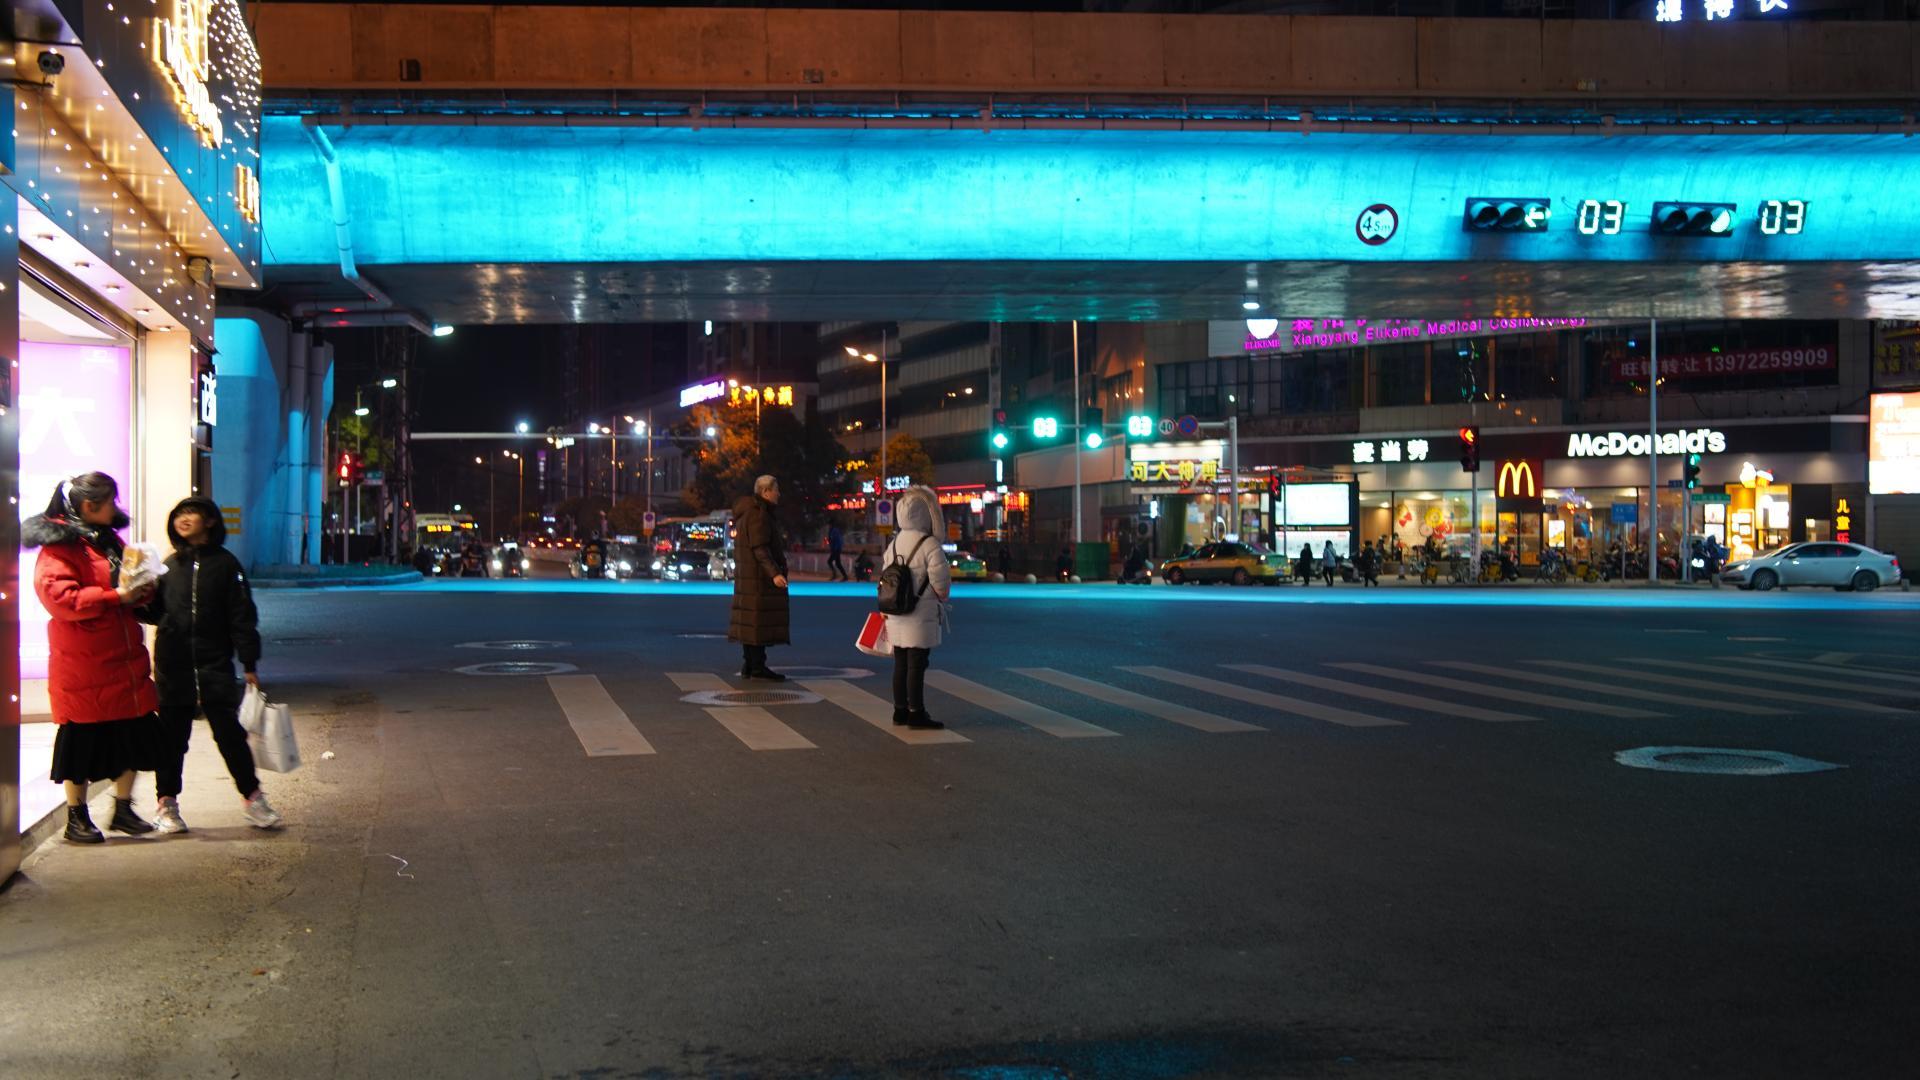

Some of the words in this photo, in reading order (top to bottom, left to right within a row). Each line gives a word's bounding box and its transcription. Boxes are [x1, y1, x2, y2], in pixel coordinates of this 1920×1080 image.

[1578, 200, 1623, 235] 03
[1761, 200, 1804, 235] 03
[1293, 331, 1358, 346] Xiangyang
[1427, 319, 1482, 335] Medical
[1705, 348, 1828, 373] 13972259909
[1160, 421, 1173, 433] 40
[1353, 439, 1429, 463] 麦当劳
[1567, 429, 1726, 457] McDonald's
